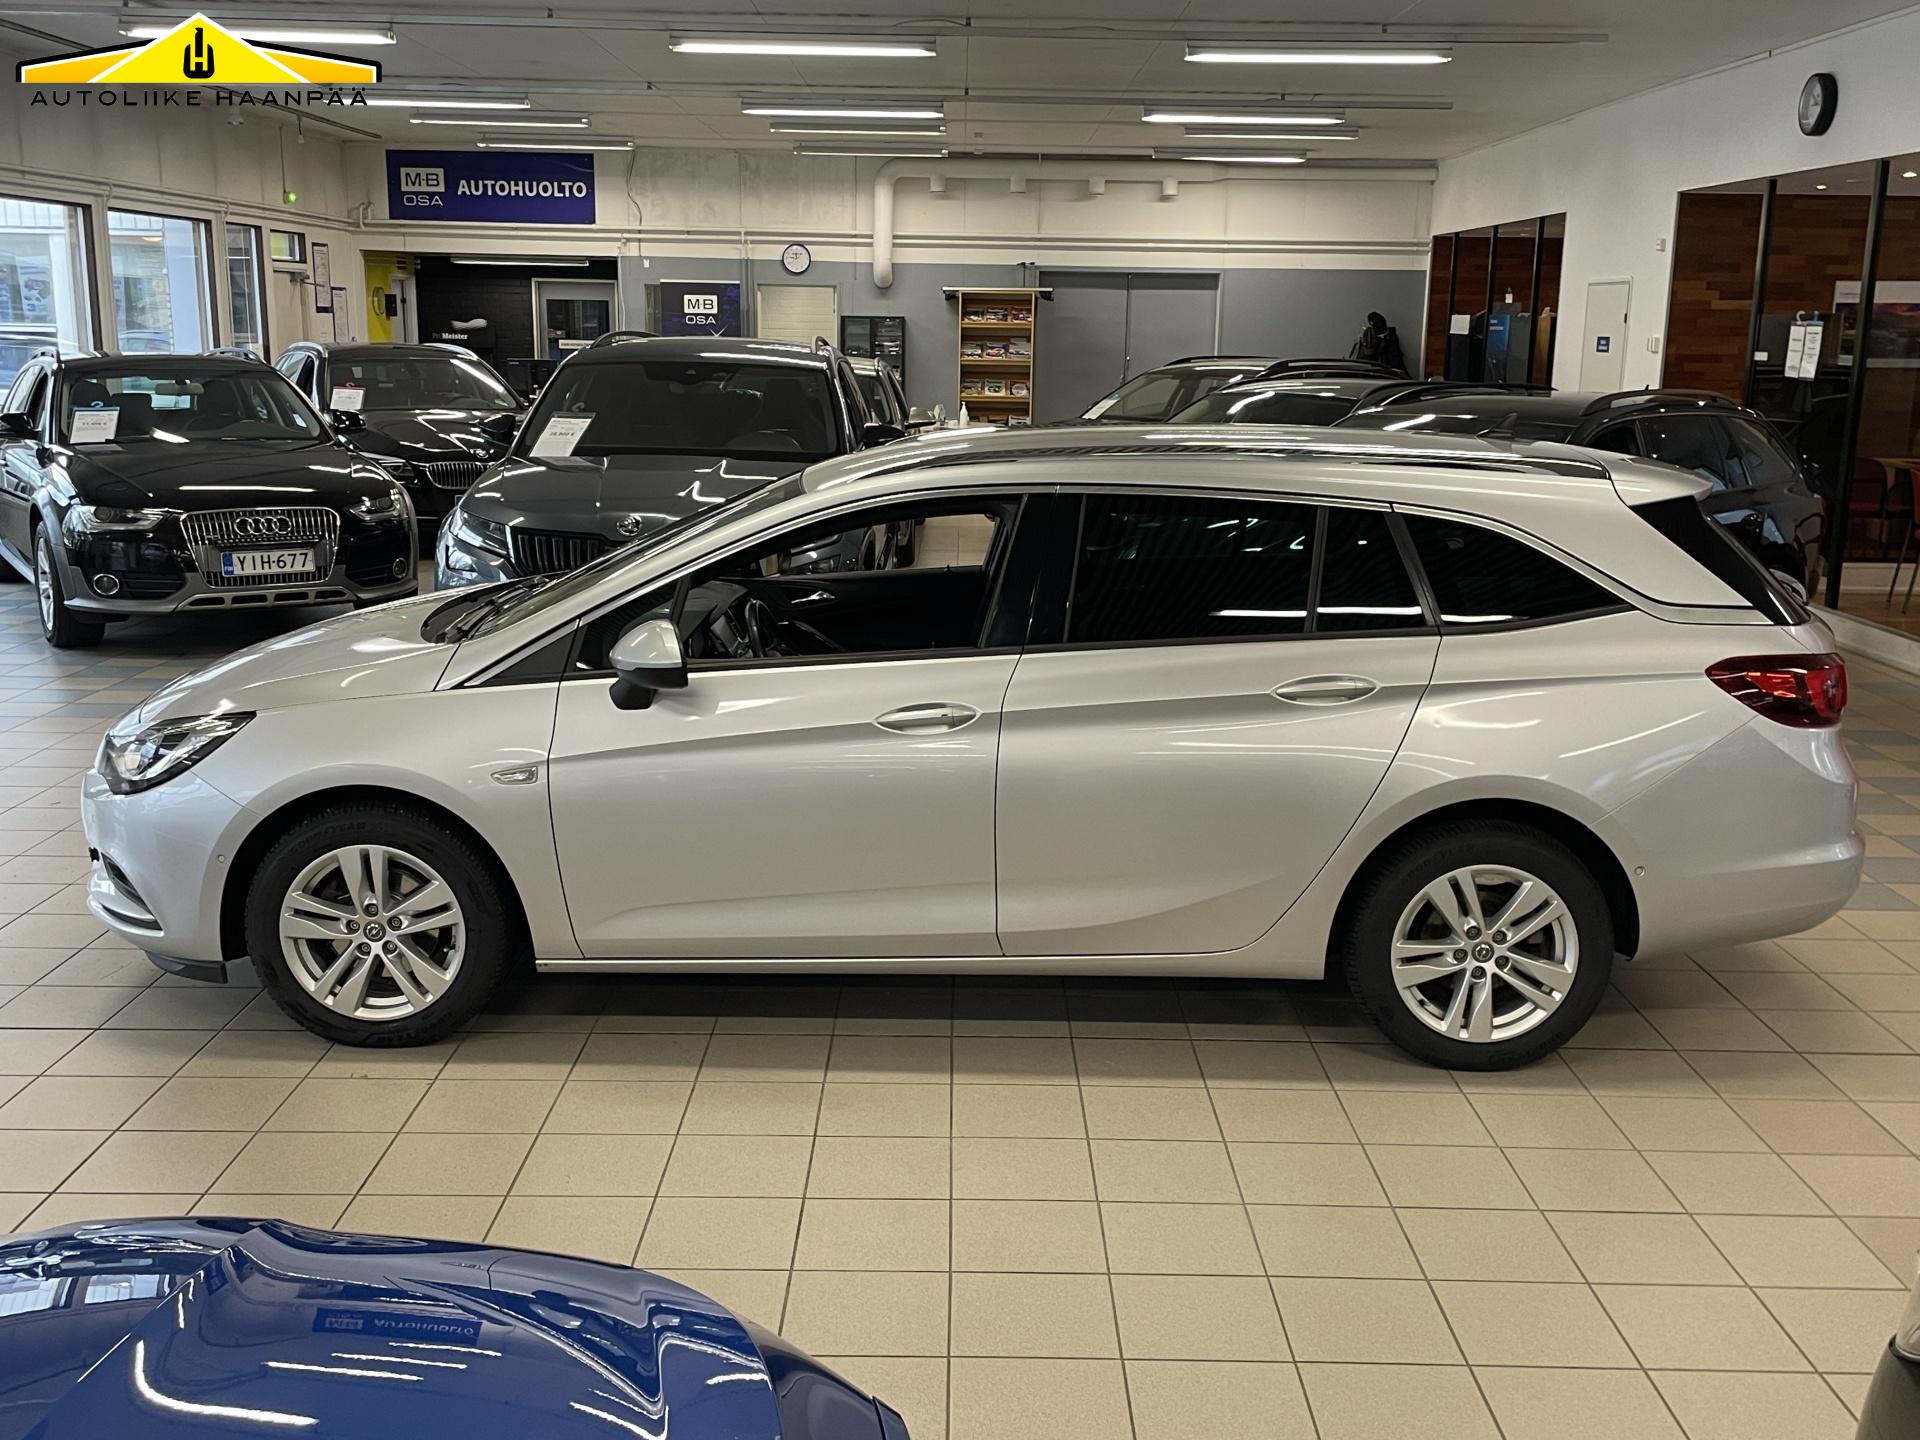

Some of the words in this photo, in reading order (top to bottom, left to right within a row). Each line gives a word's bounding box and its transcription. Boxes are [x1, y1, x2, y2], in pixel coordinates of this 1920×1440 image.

[457, 179, 588, 198] AUTOHUOLTO
[403, 194, 444, 207] OSA
[685, 315, 717, 325] OSA
[236, 552, 309, 572] YIH-677
